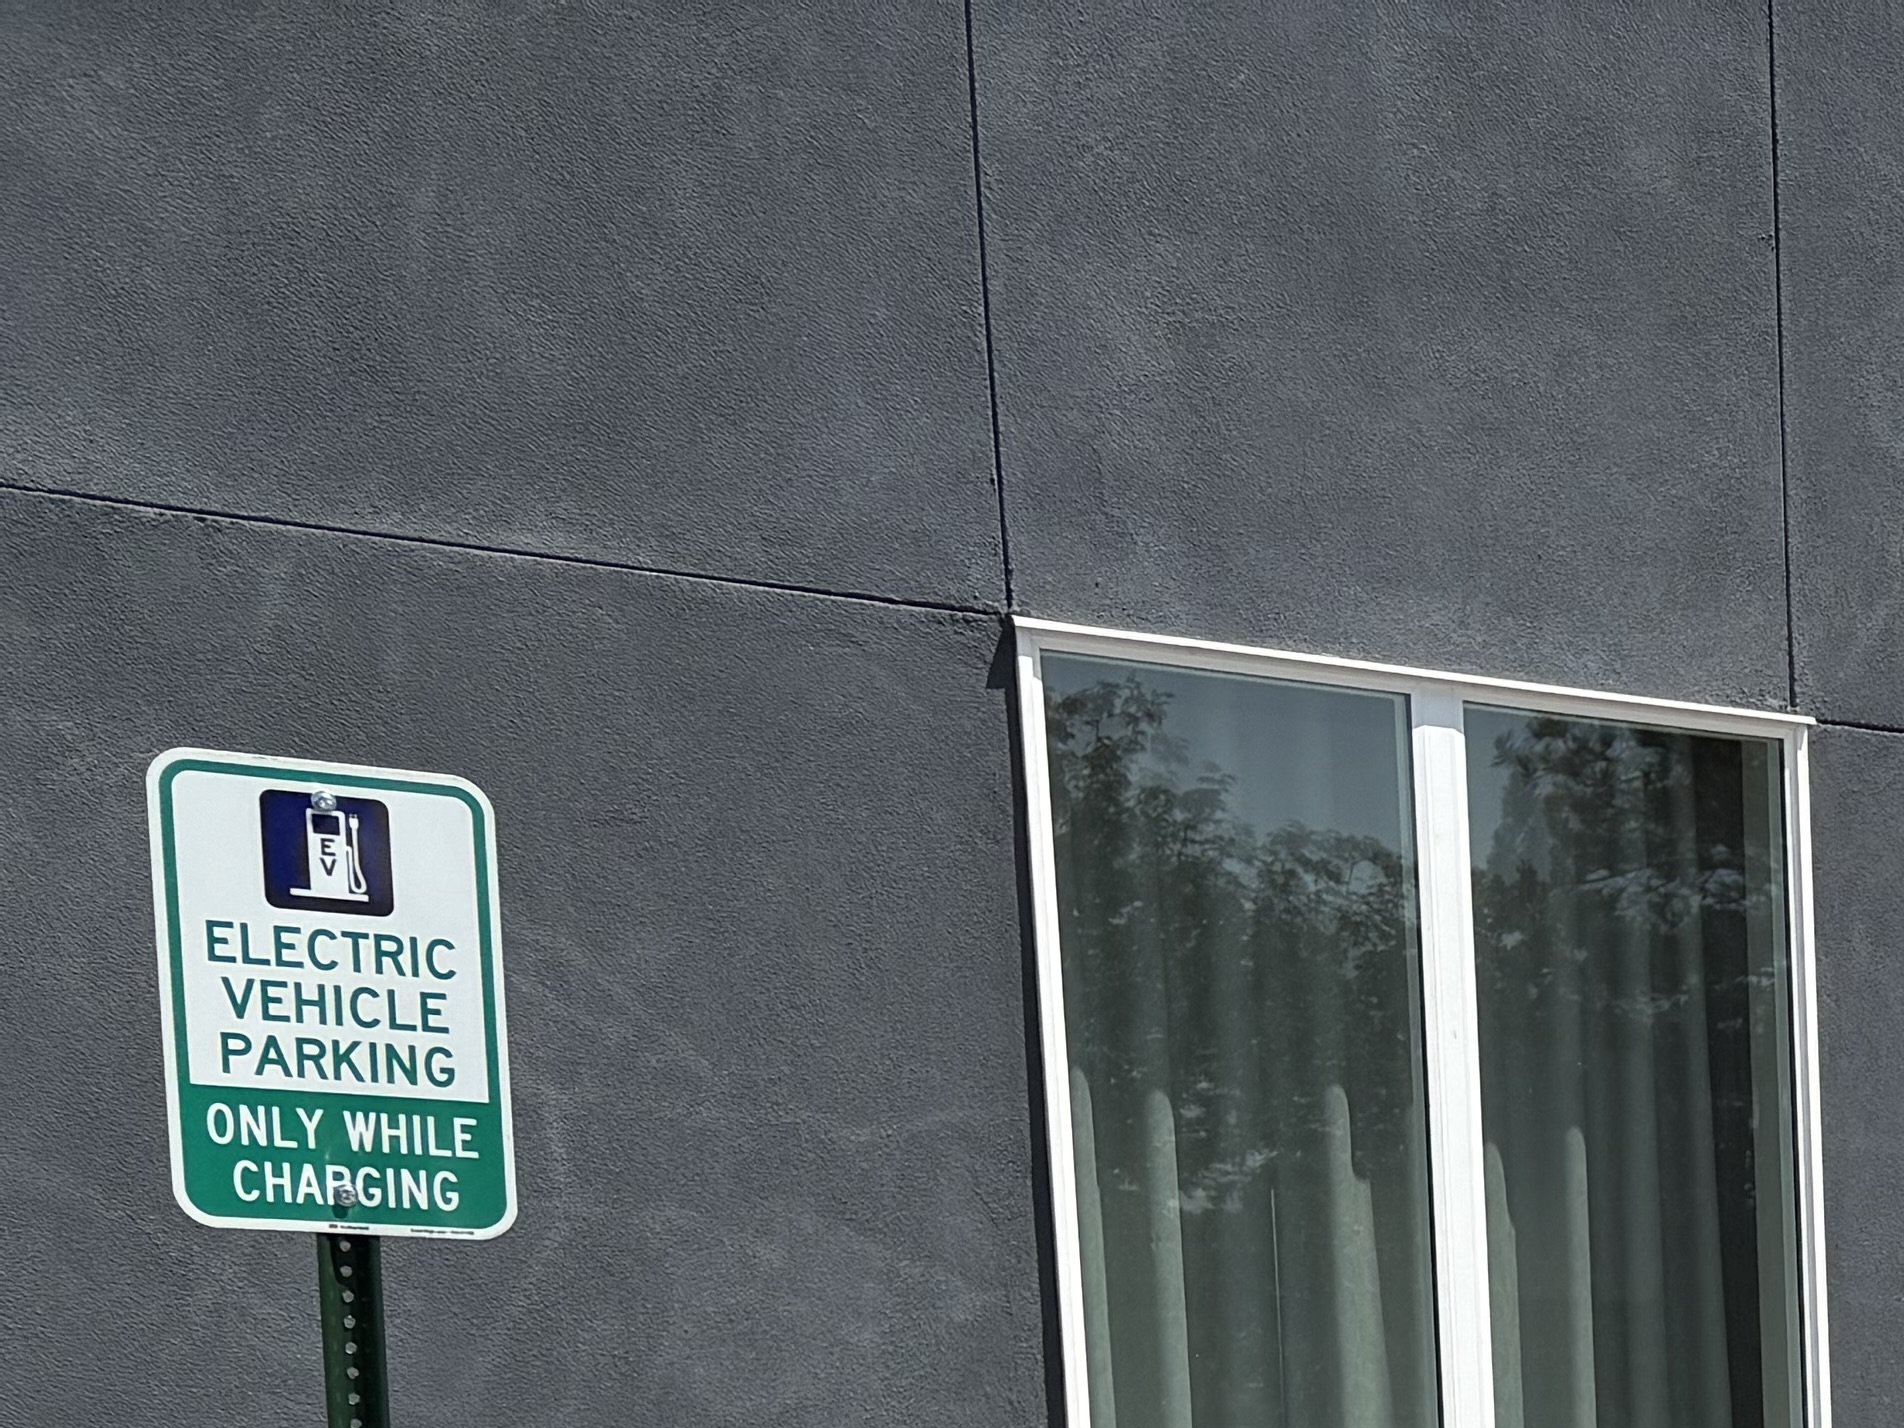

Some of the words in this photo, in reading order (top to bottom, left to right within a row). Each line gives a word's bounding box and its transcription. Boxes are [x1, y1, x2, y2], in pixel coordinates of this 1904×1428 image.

[205, 919, 457, 981] ELECTRIC
[220, 976, 450, 1034] VEHICLE
[220, 1031, 456, 1088] PARKING
[206, 1102, 324, 1150] ONLY
[342, 1110, 480, 1159] WHILE
[232, 1159, 460, 1212] CHARGING
